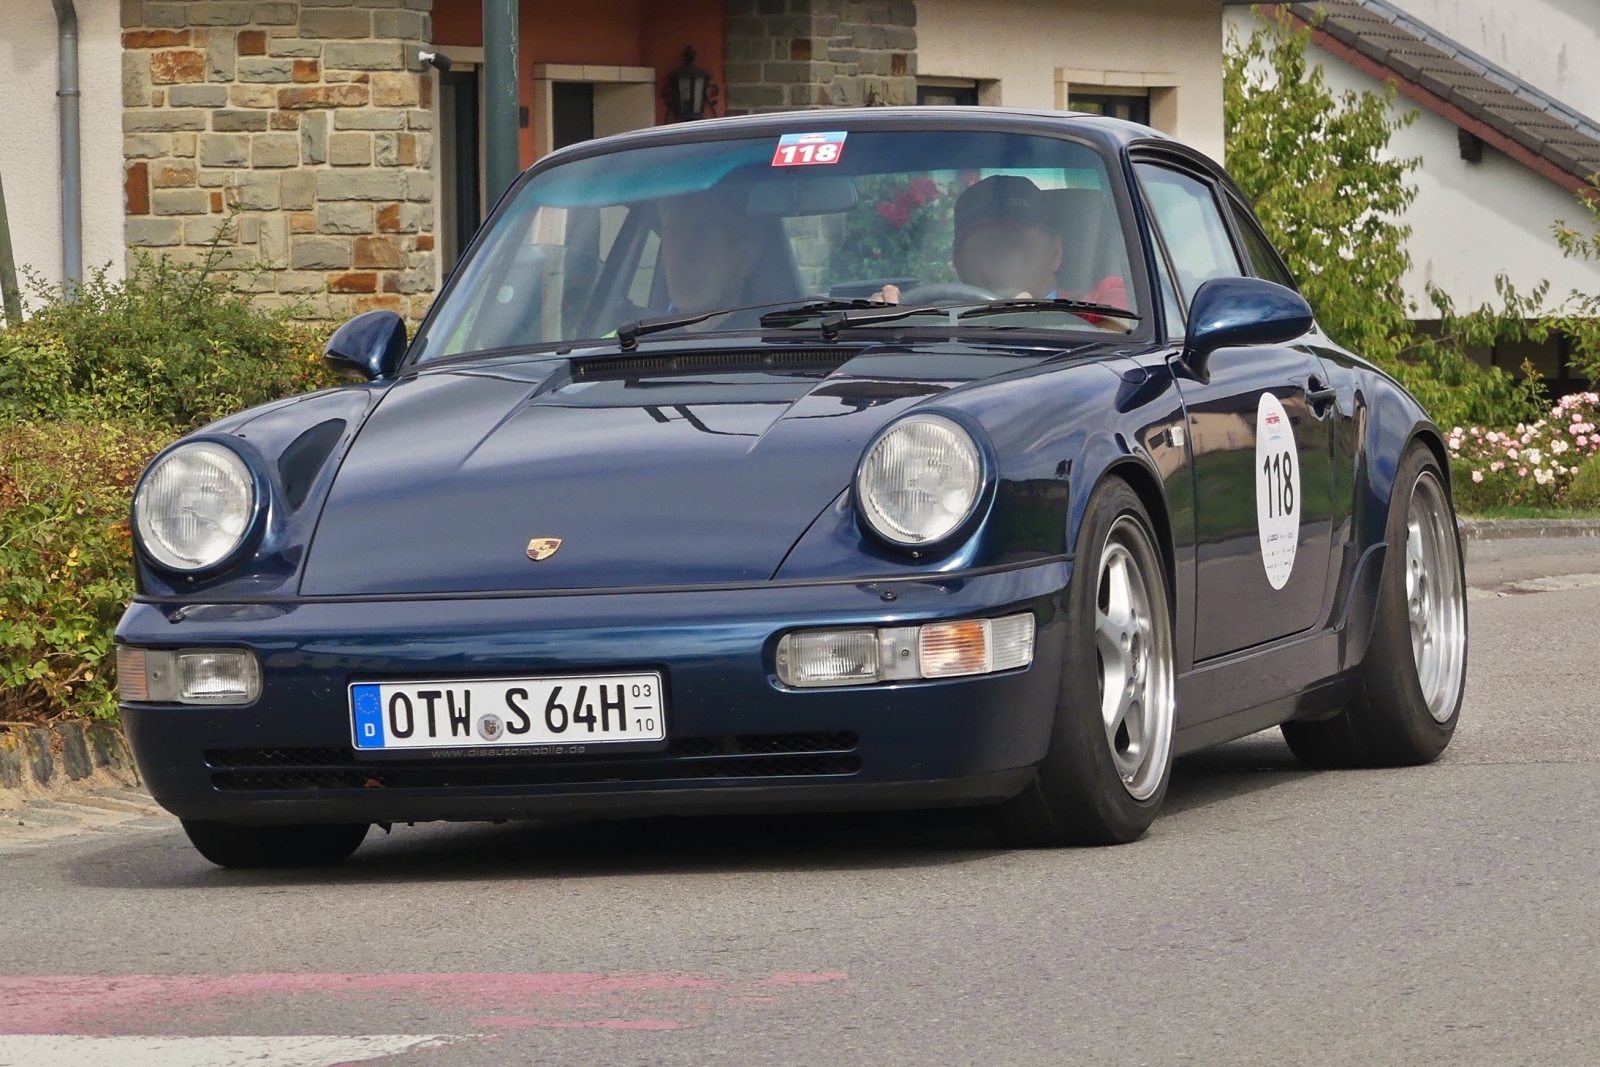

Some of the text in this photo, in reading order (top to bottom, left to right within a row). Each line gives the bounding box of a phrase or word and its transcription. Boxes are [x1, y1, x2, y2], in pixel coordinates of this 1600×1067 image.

[781, 144, 838, 163] 118
[1264, 451, 1294, 519] 118
[632, 684, 652, 698] 03
[389, 689, 471, 739] OTW
[506, 688, 531, 735] S
[545, 684, 627, 733] 64H
[365, 723, 375, 737] D
[636, 718, 654, 731] 10
